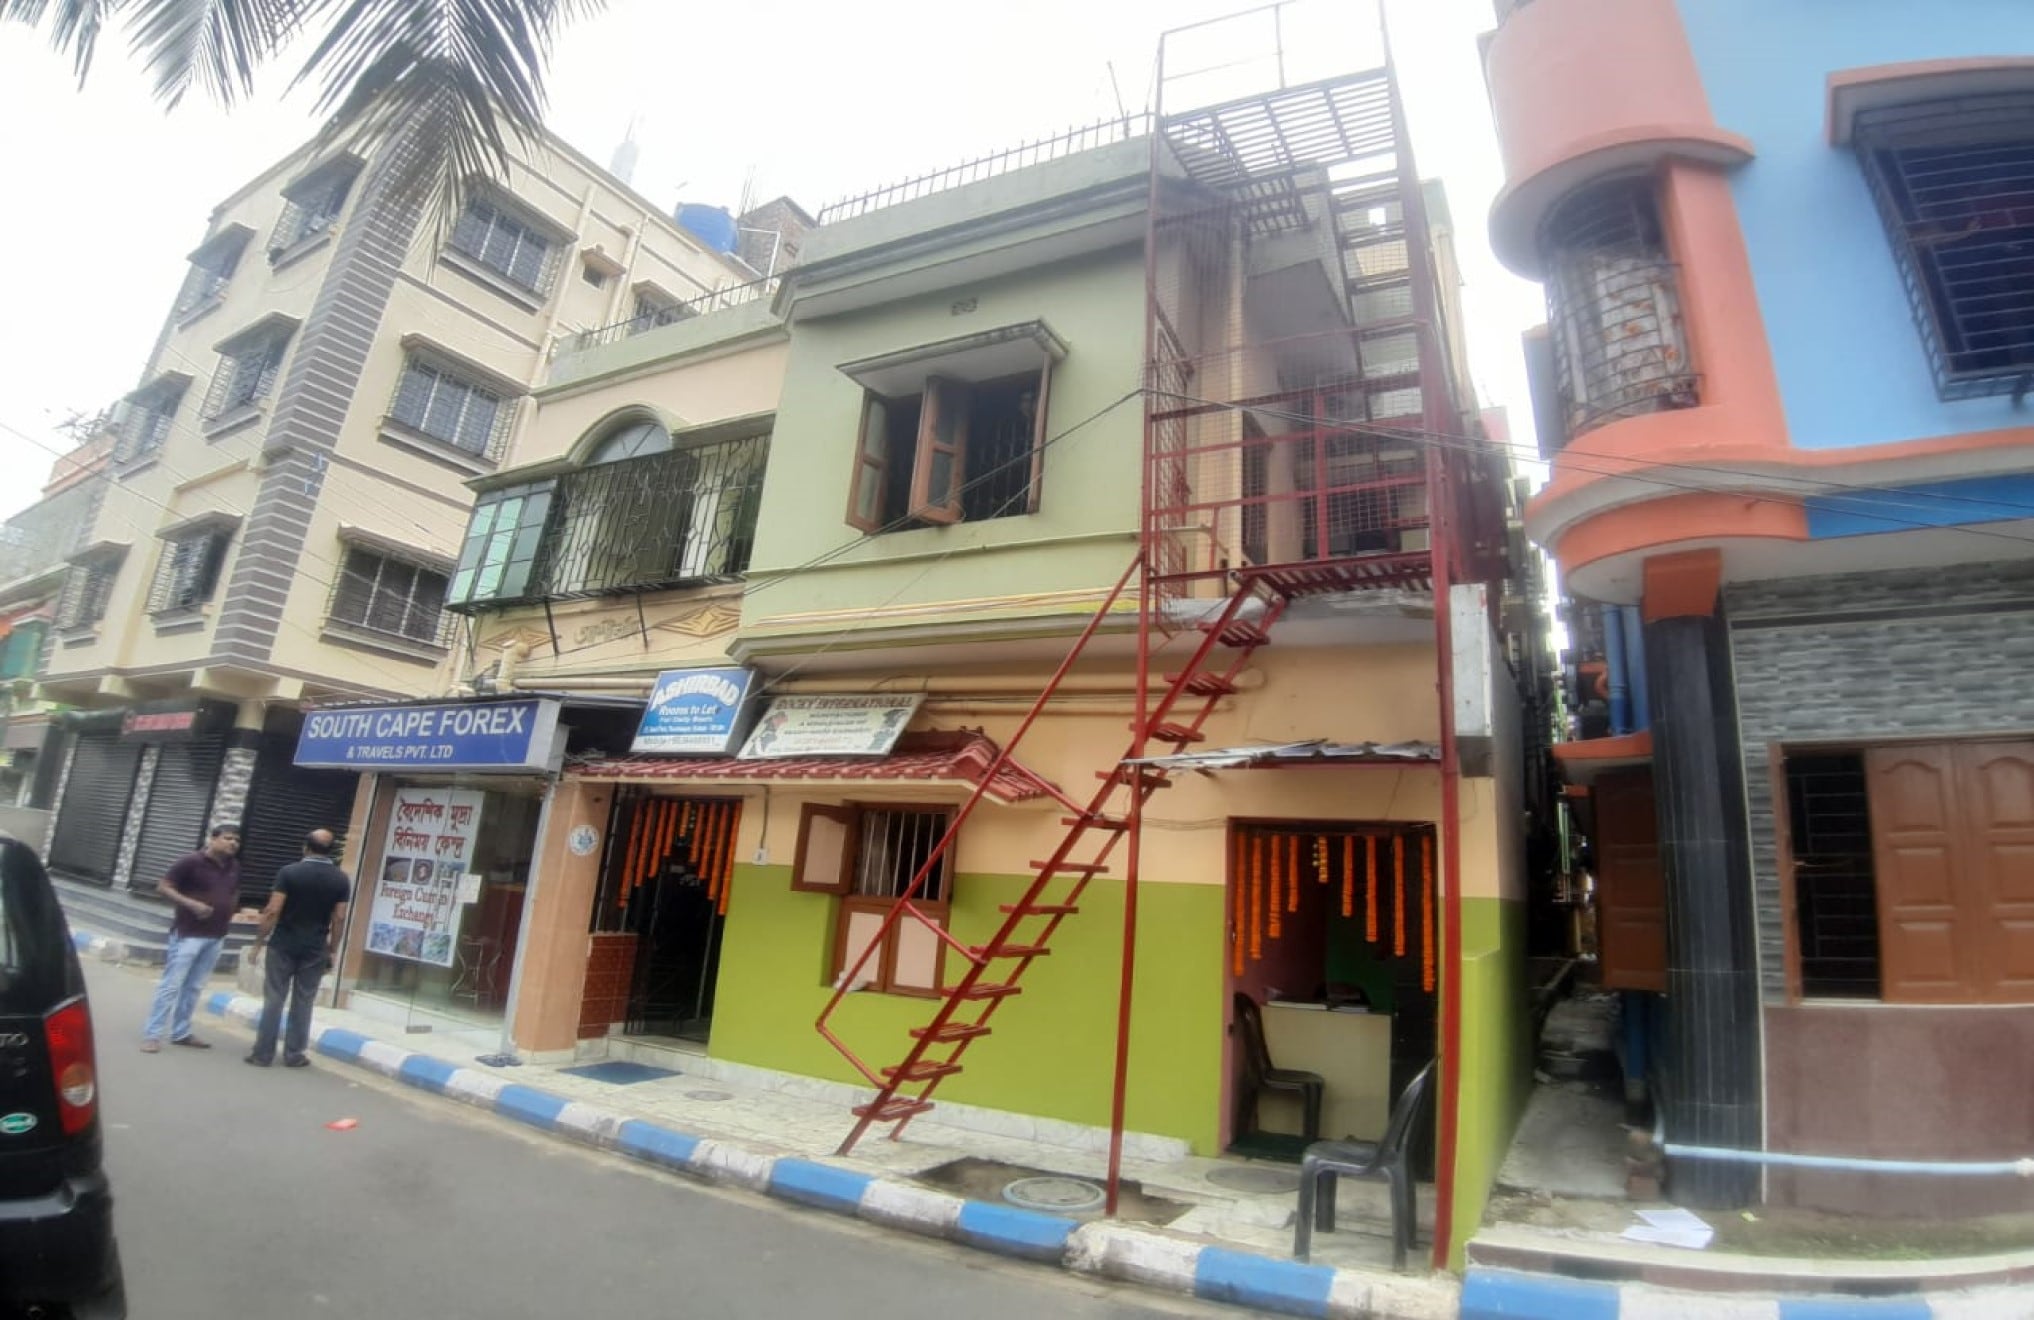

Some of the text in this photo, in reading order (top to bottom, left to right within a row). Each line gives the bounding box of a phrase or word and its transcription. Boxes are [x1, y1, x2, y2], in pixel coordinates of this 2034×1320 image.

[308, 706, 529, 739] SOUTH CAPE FOREX
[346, 745, 355, 759] &
[357, 745, 403, 759] TRAVELS
[430, 744, 454, 759] LTD
[450, 803, 473, 833] মুদ্রা
[391, 826, 431, 853] বিনিময়
[381, 882, 413, 906] Foreign
